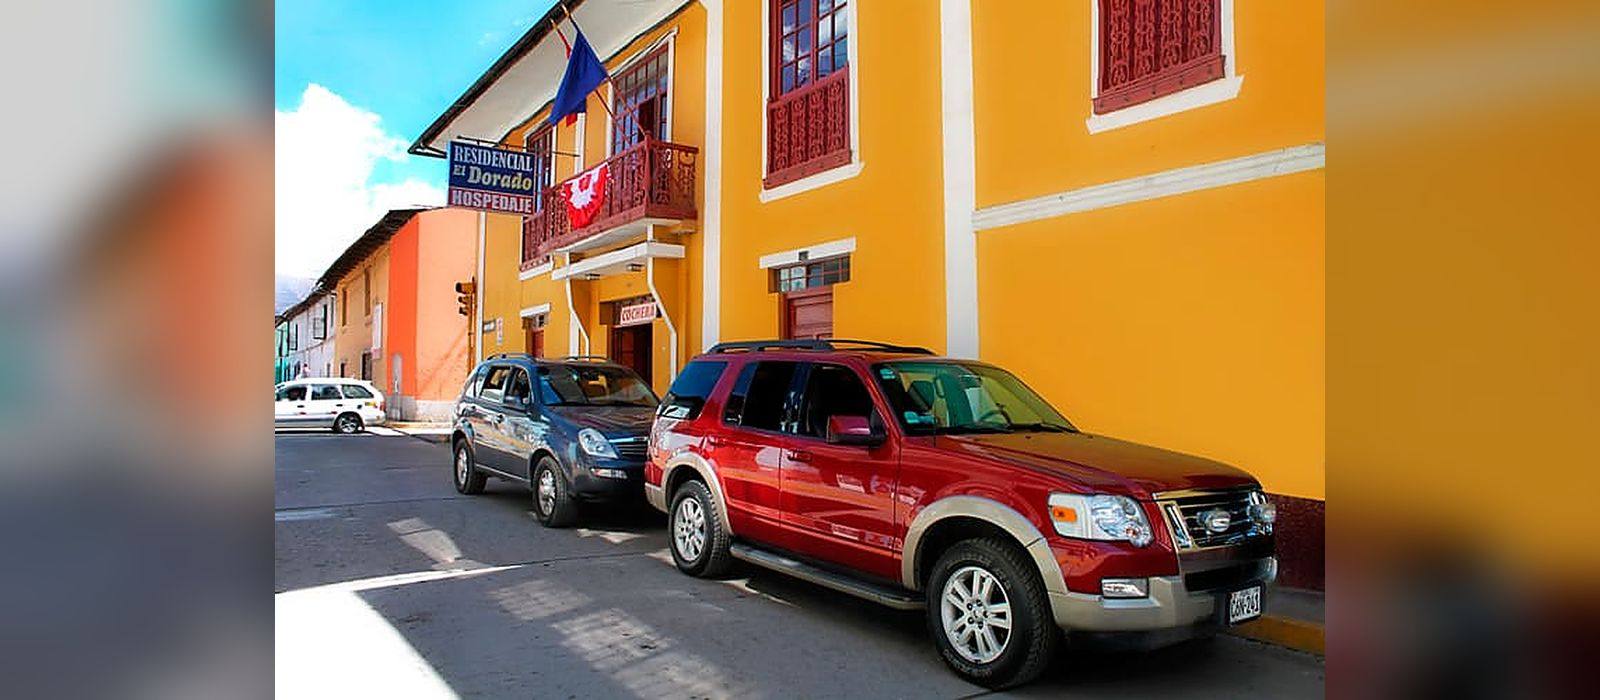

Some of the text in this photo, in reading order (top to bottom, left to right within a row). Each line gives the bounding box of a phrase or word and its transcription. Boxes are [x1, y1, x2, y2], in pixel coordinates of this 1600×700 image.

[454, 145, 533, 171] RESIDENCIAL
[453, 164, 532, 190] El Dorado
[452, 190, 532, 213] HOSPEDAJE
